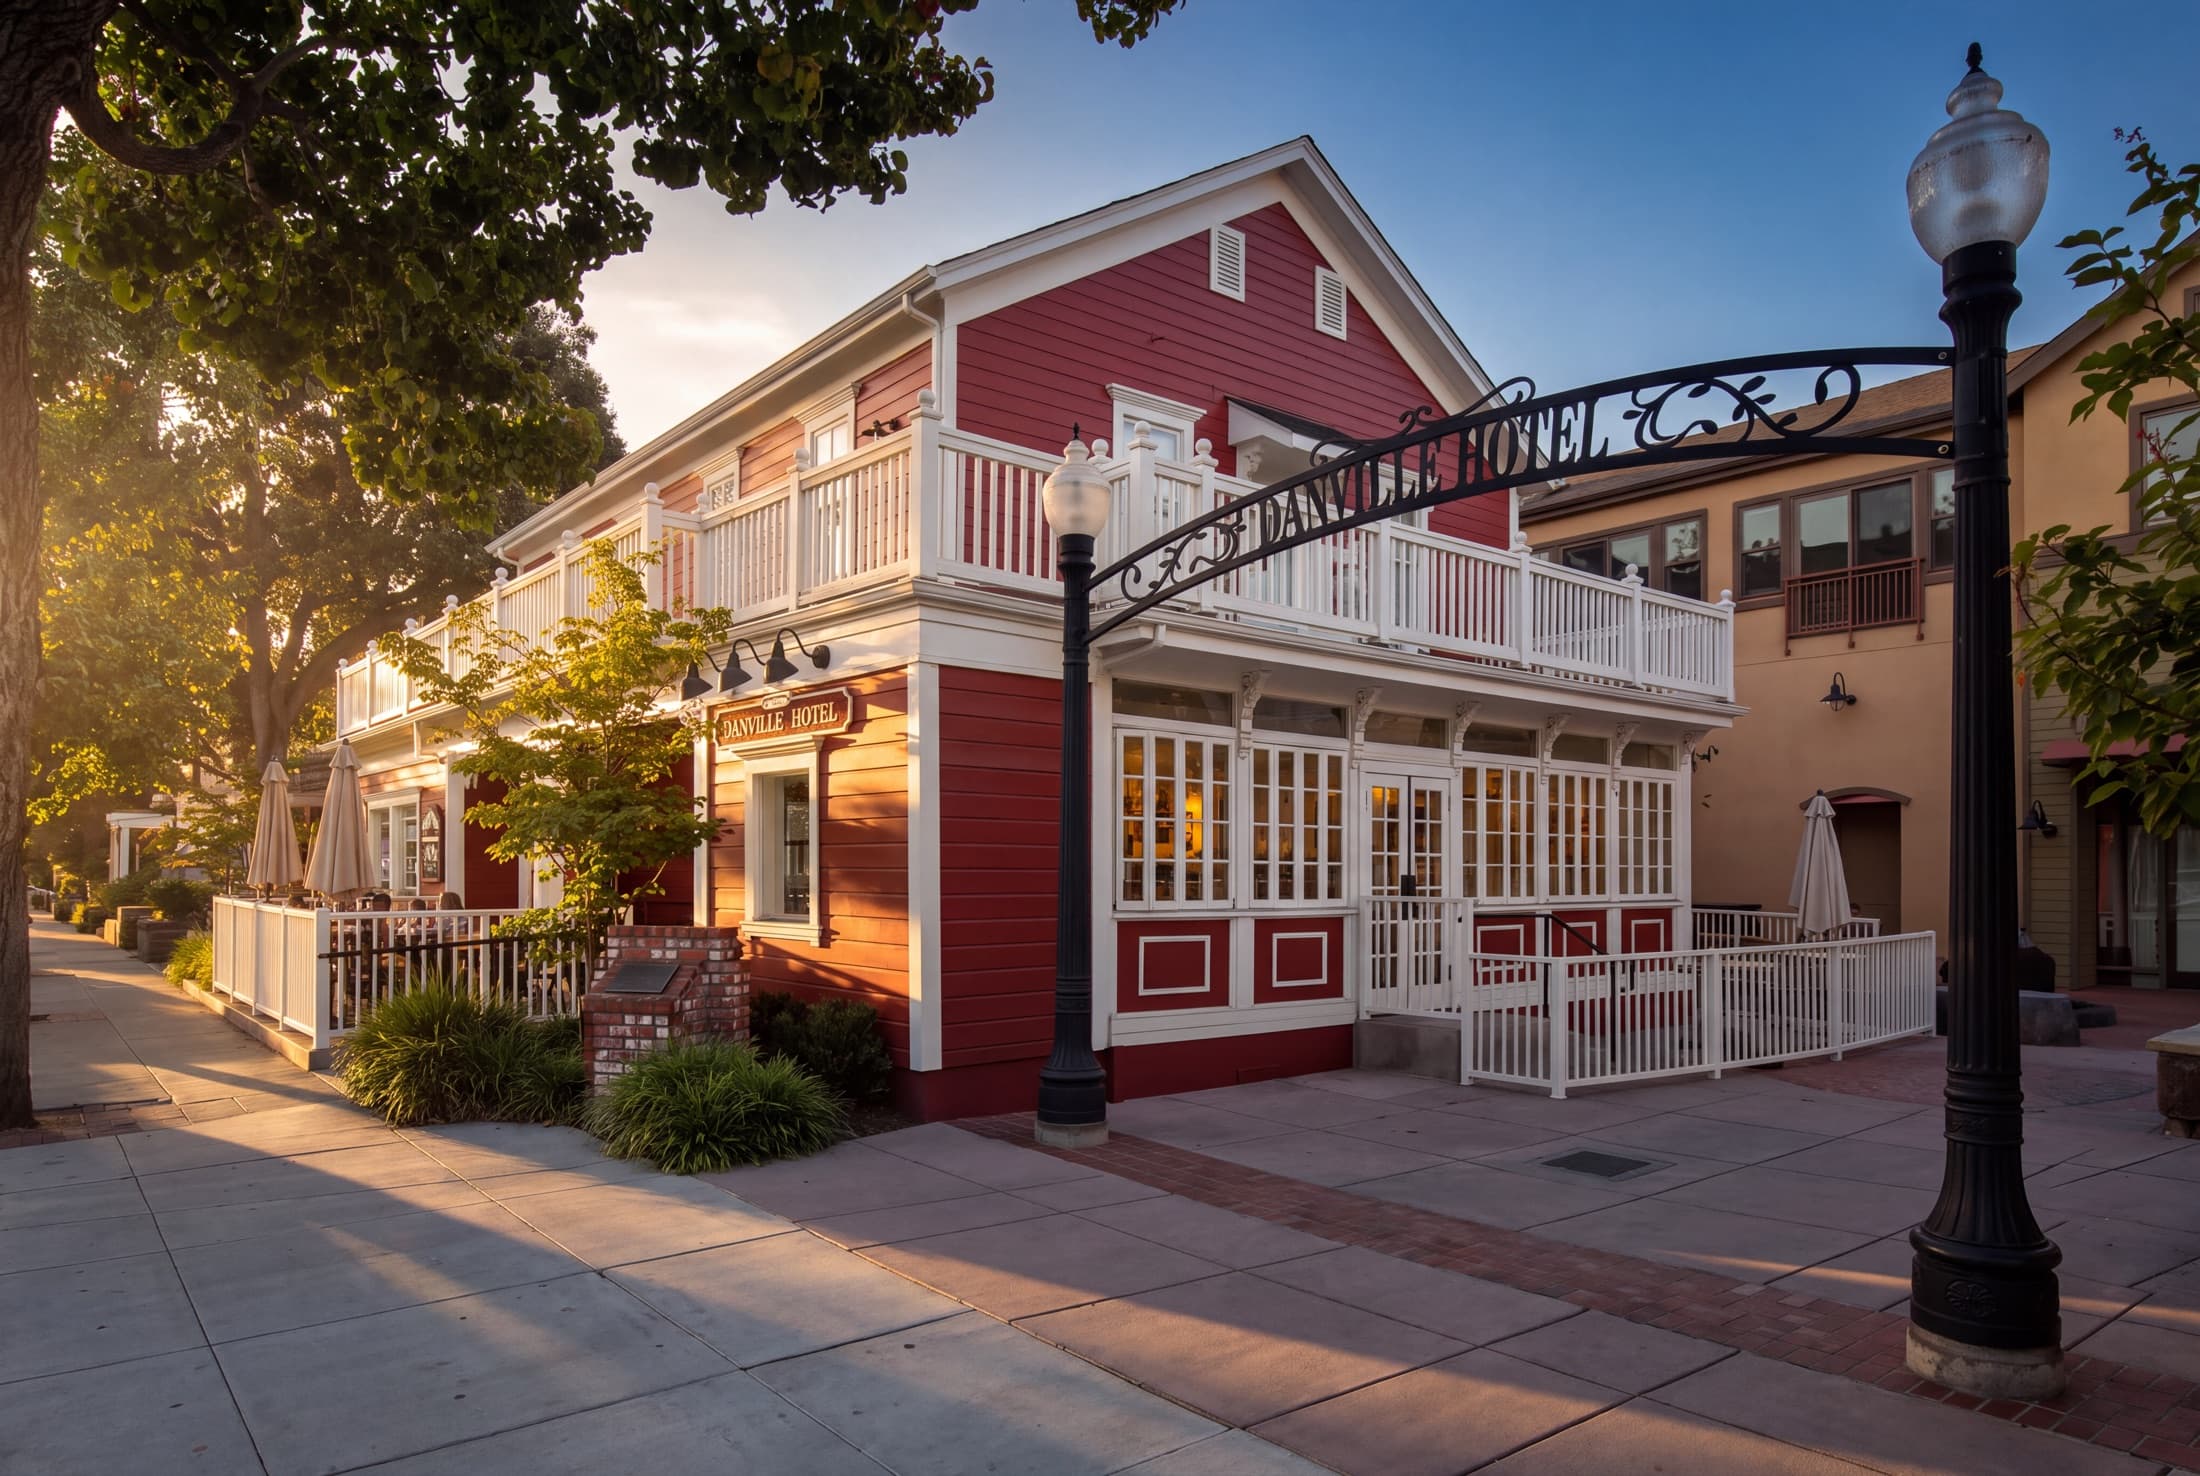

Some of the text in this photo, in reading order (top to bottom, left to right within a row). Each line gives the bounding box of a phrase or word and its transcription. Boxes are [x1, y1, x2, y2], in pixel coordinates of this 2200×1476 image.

[1259, 401, 1608, 543] DANVILLE HOTEL
[723, 711, 784, 739] DANVILLE
[792, 702, 838, 728] HOTEL
